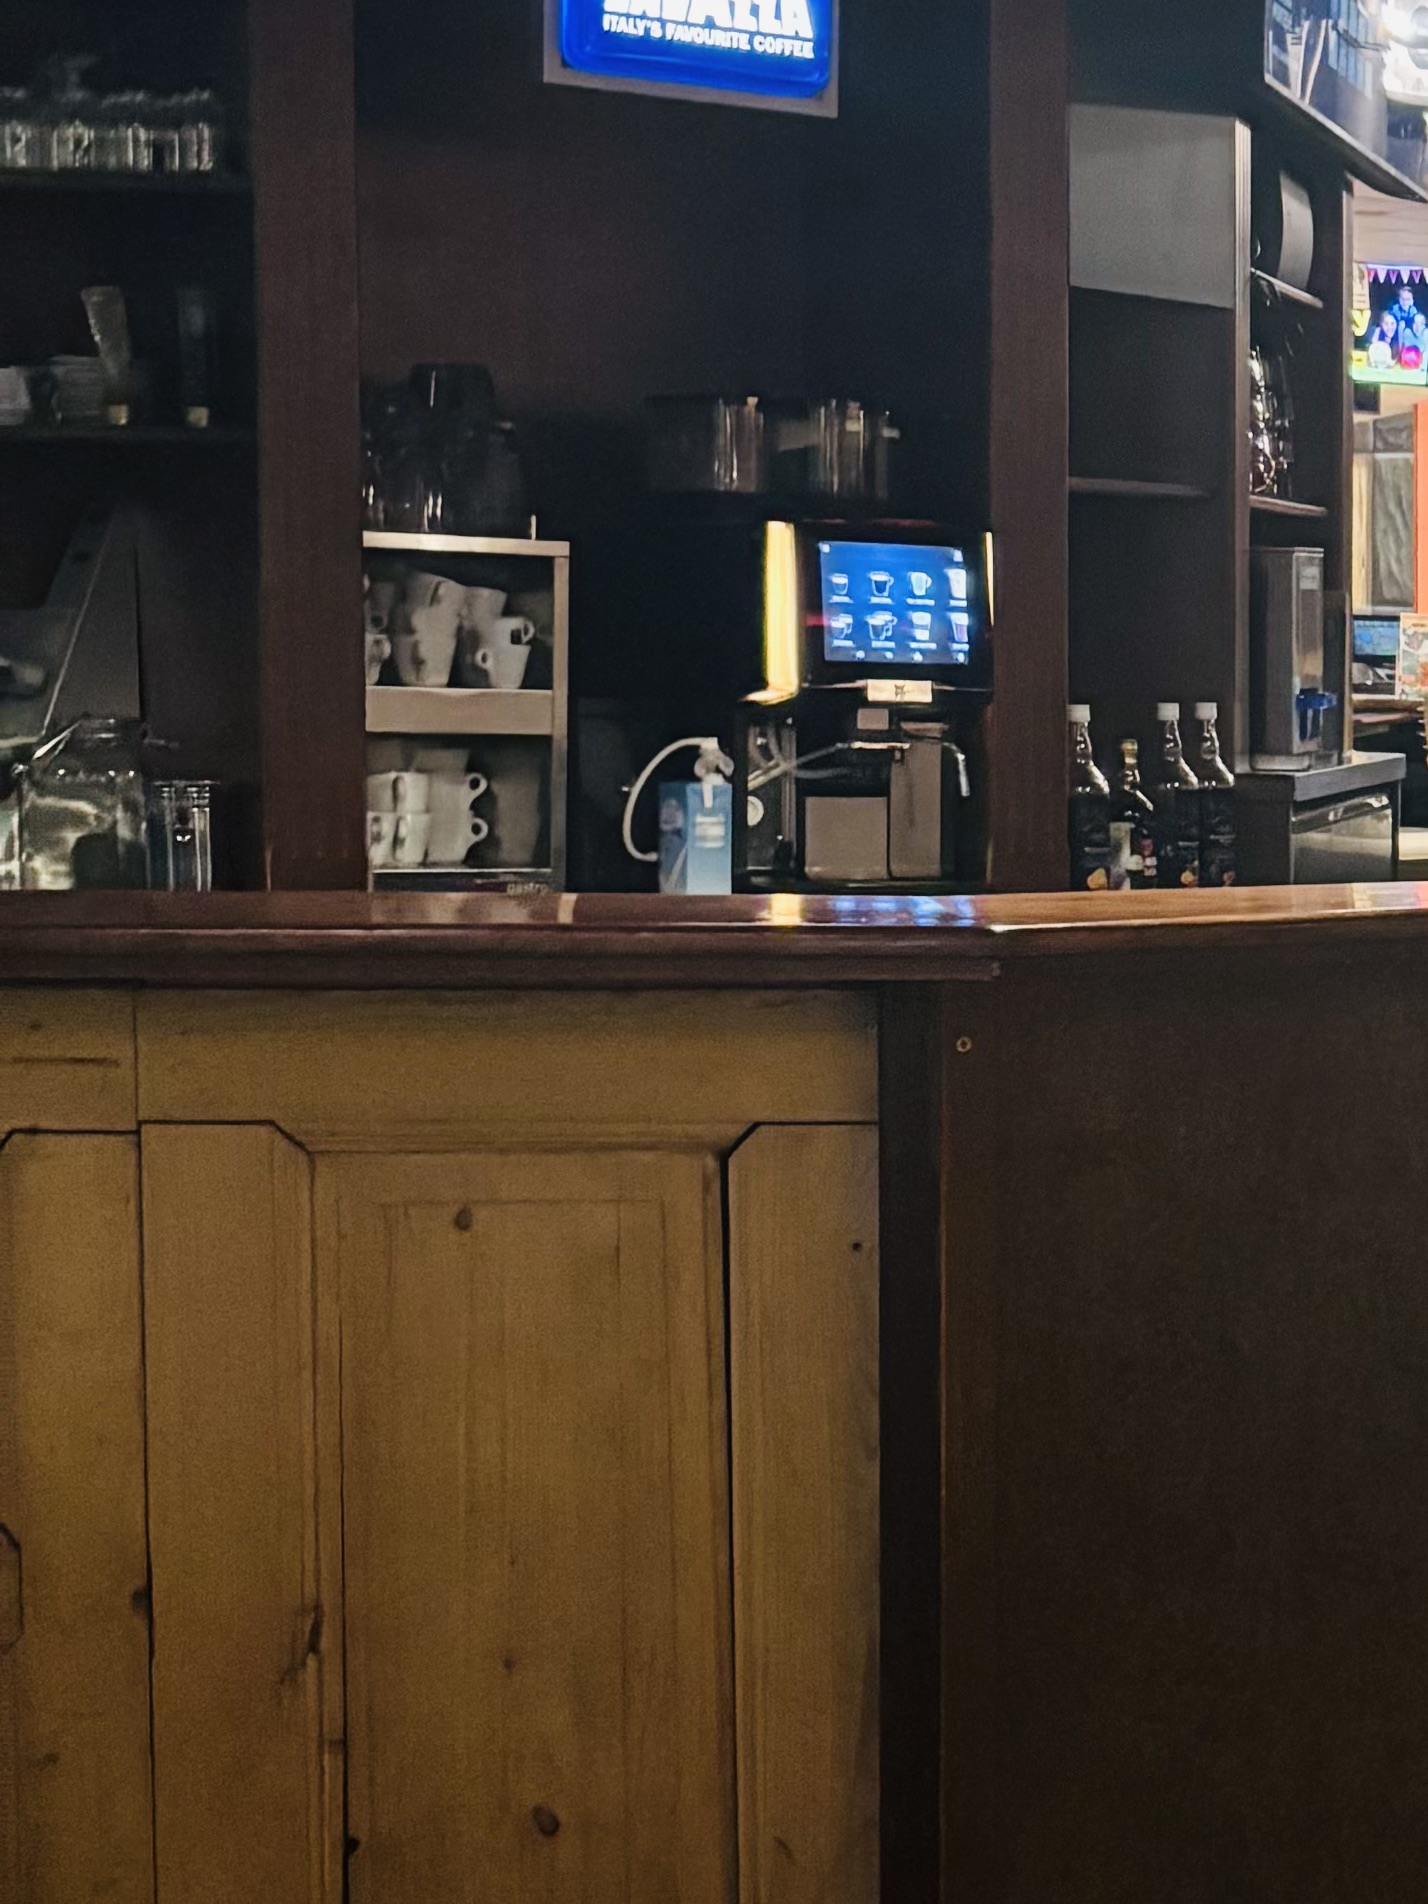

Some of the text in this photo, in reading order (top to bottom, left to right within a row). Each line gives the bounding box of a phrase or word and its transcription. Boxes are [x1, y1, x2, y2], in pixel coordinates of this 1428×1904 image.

[602, 13, 816, 60] ITALY'S FAVOURITE COFFEE
